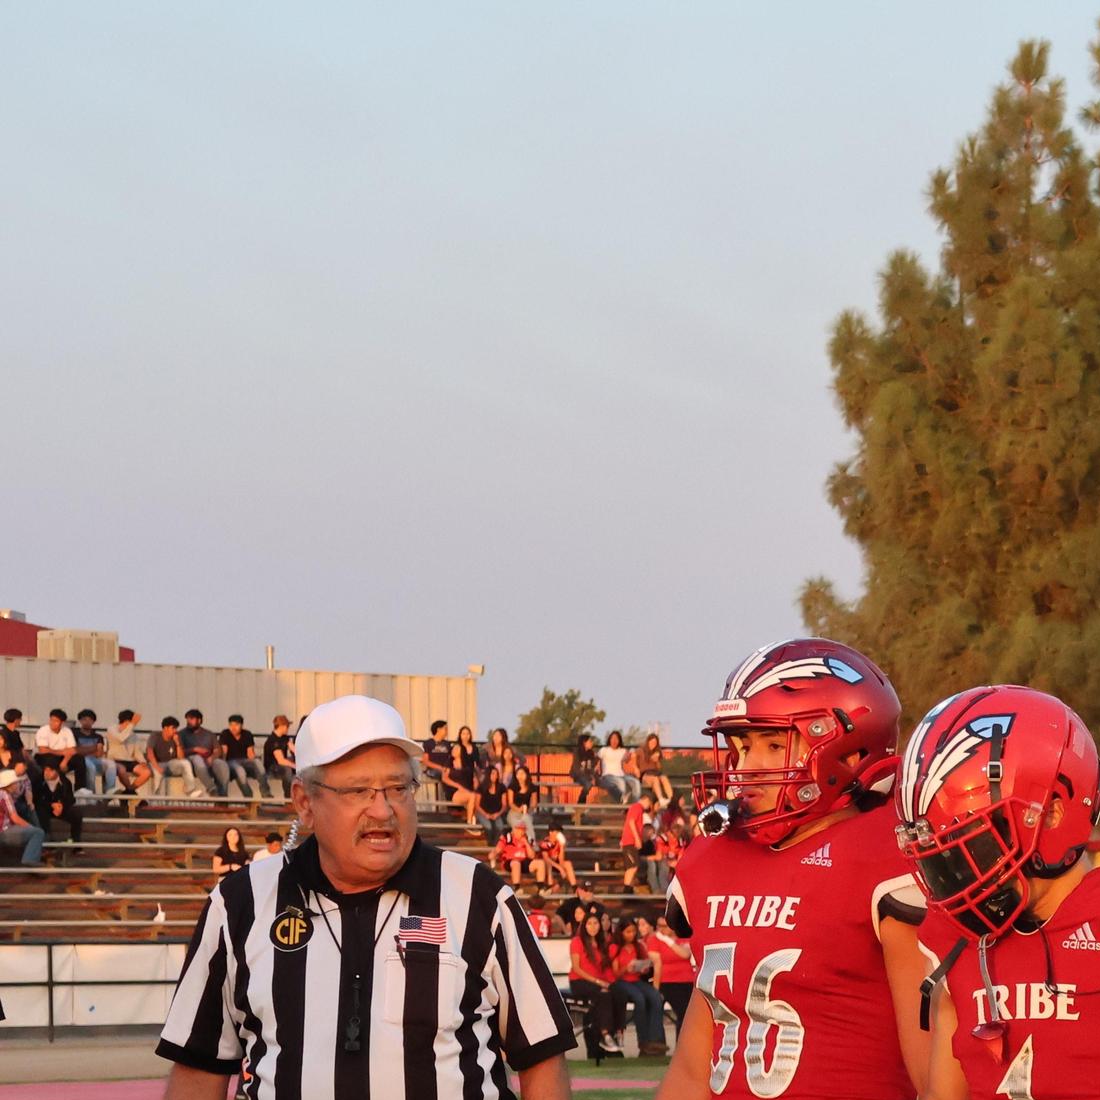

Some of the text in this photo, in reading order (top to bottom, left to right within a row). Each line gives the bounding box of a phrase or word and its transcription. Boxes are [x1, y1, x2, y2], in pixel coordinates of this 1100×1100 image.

[801, 853, 833, 867] adidas
[706, 895, 801, 931] TRIBE
[275, 917, 308, 946] CIF
[696, 941, 805, 1099] 56
[972, 982, 1081, 1025] TRIBE
